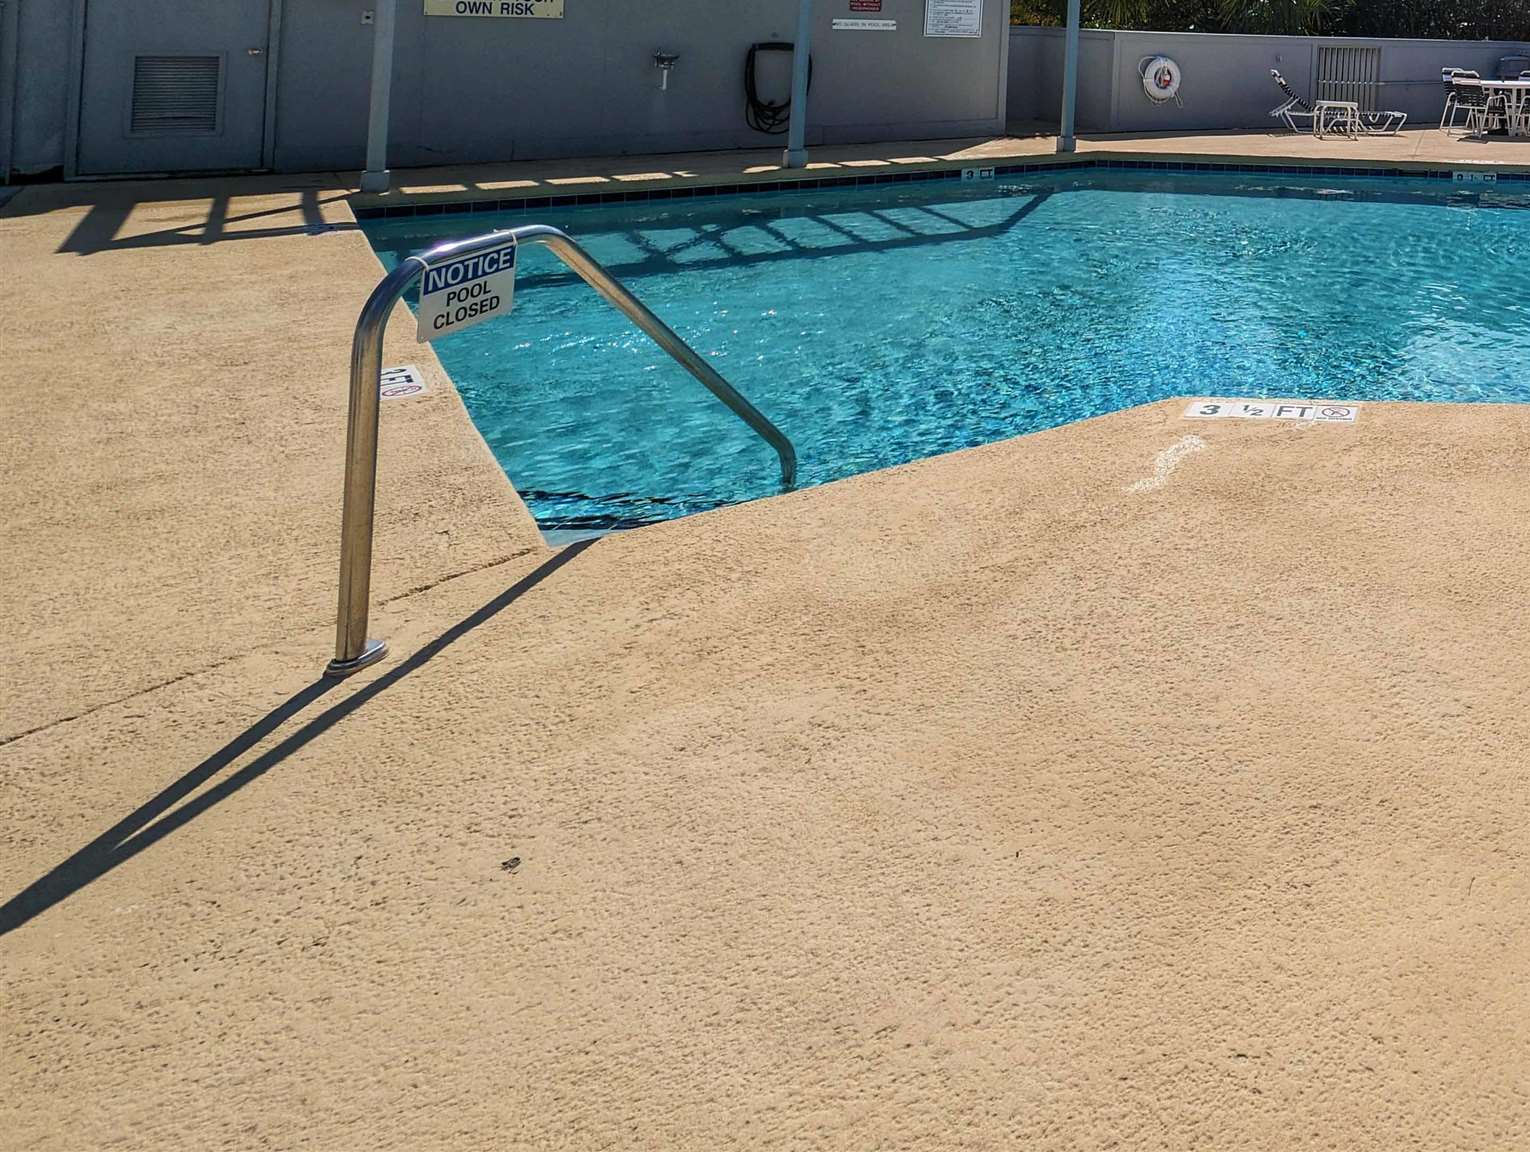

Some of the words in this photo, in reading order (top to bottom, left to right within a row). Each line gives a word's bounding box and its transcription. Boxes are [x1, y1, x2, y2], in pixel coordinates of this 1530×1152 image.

[455, 0, 493, 15] OWN
[500, 2, 535, 16] RISK
[427, 247, 512, 292] NOTICE
[446, 280, 491, 307] POOL
[433, 296, 500, 330] CLOSED
[1199, 404, 1221, 416] 3
[1276, 405, 1313, 418] FT
